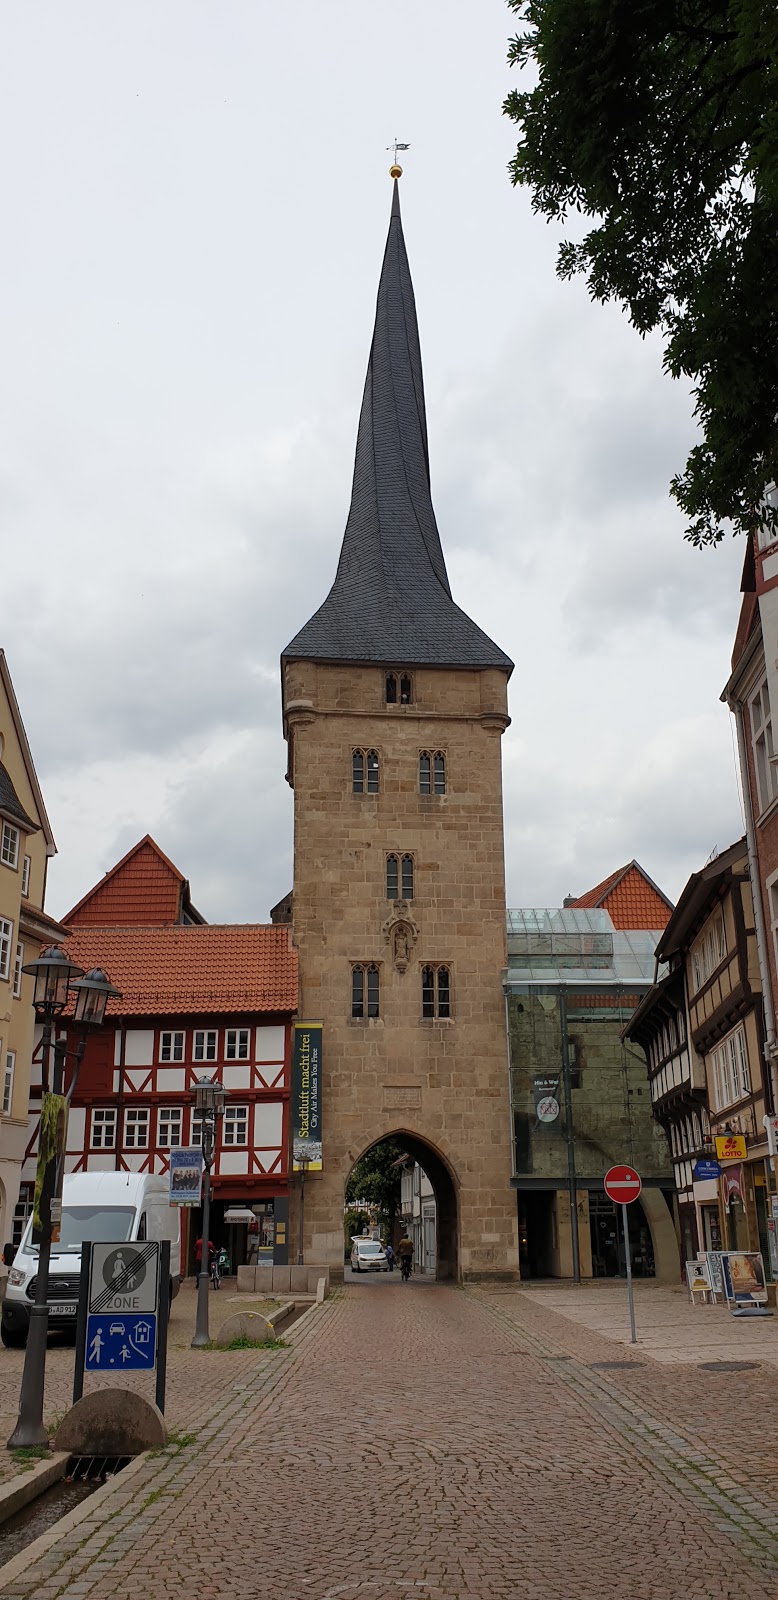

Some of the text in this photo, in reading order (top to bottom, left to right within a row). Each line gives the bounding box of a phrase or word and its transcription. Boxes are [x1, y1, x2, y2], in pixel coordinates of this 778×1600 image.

[298, 1034, 310, 1138] Stadtluft macht frei
[310, 1114, 319, 1128] City
[106, 1297, 140, 1308] ZONE
